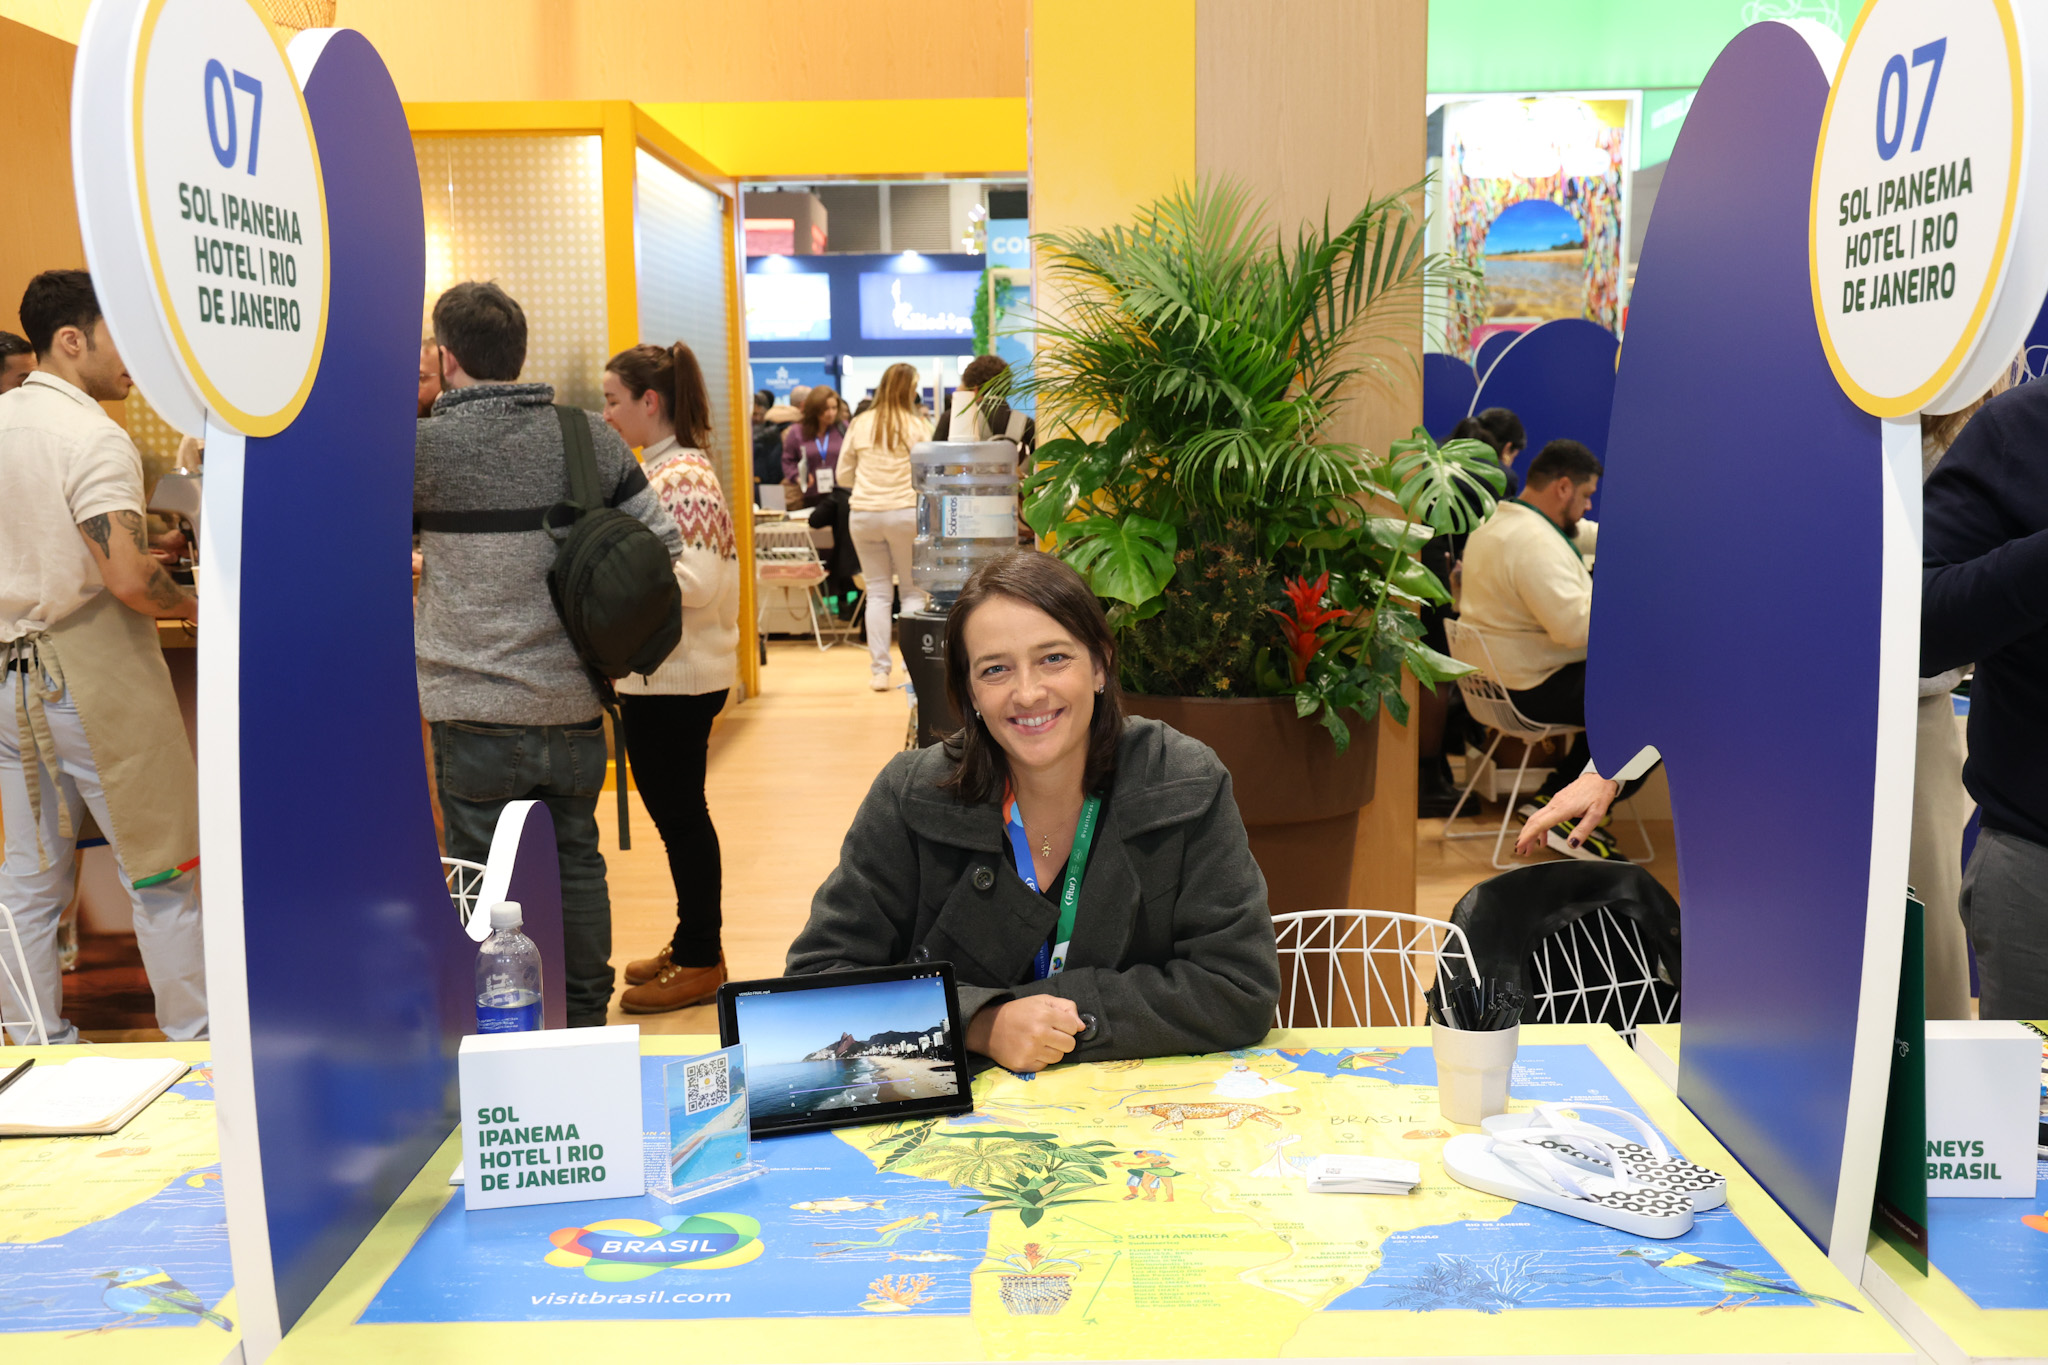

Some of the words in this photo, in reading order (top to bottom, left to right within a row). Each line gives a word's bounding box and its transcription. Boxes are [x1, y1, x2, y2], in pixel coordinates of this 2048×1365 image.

[204, 59, 263, 176] 07
[1876, 37, 1947, 161] 07
[1839, 187, 1871, 227] SOL
[1877, 157, 1972, 213] IPANEMA
[179, 182, 218, 227] SOL
[223, 194, 303, 246] IPANEMA
[1845, 226, 1905, 269] HOTEL
[1922, 212, 1958, 254] RIO
[195, 236, 256, 283] HOTEL
[269, 250, 297, 287] RIO
[1842, 278, 1865, 314] DE
[1870, 263, 1956, 310] JANEIRO
[199, 286, 225, 324] DE
[230, 291, 300, 332] JANEIRO
[948, 497, 958, 536] Sobreiros
[478, 1106, 519, 1125] SOL
[1330, 1115, 1426, 1126] BRASIL
[479, 1125, 580, 1147] IPANEMA
[480, 1147, 551, 1169] HOTEL
[568, 1144, 603, 1163] RIO
[1926, 1163, 2002, 1180] BRASIL
[481, 1172, 511, 1191] DE
[516, 1165, 606, 1189] JANEIRO
[600, 1240, 718, 1254] BRASIL
[531, 1291, 732, 1306] visitbrasil.com
